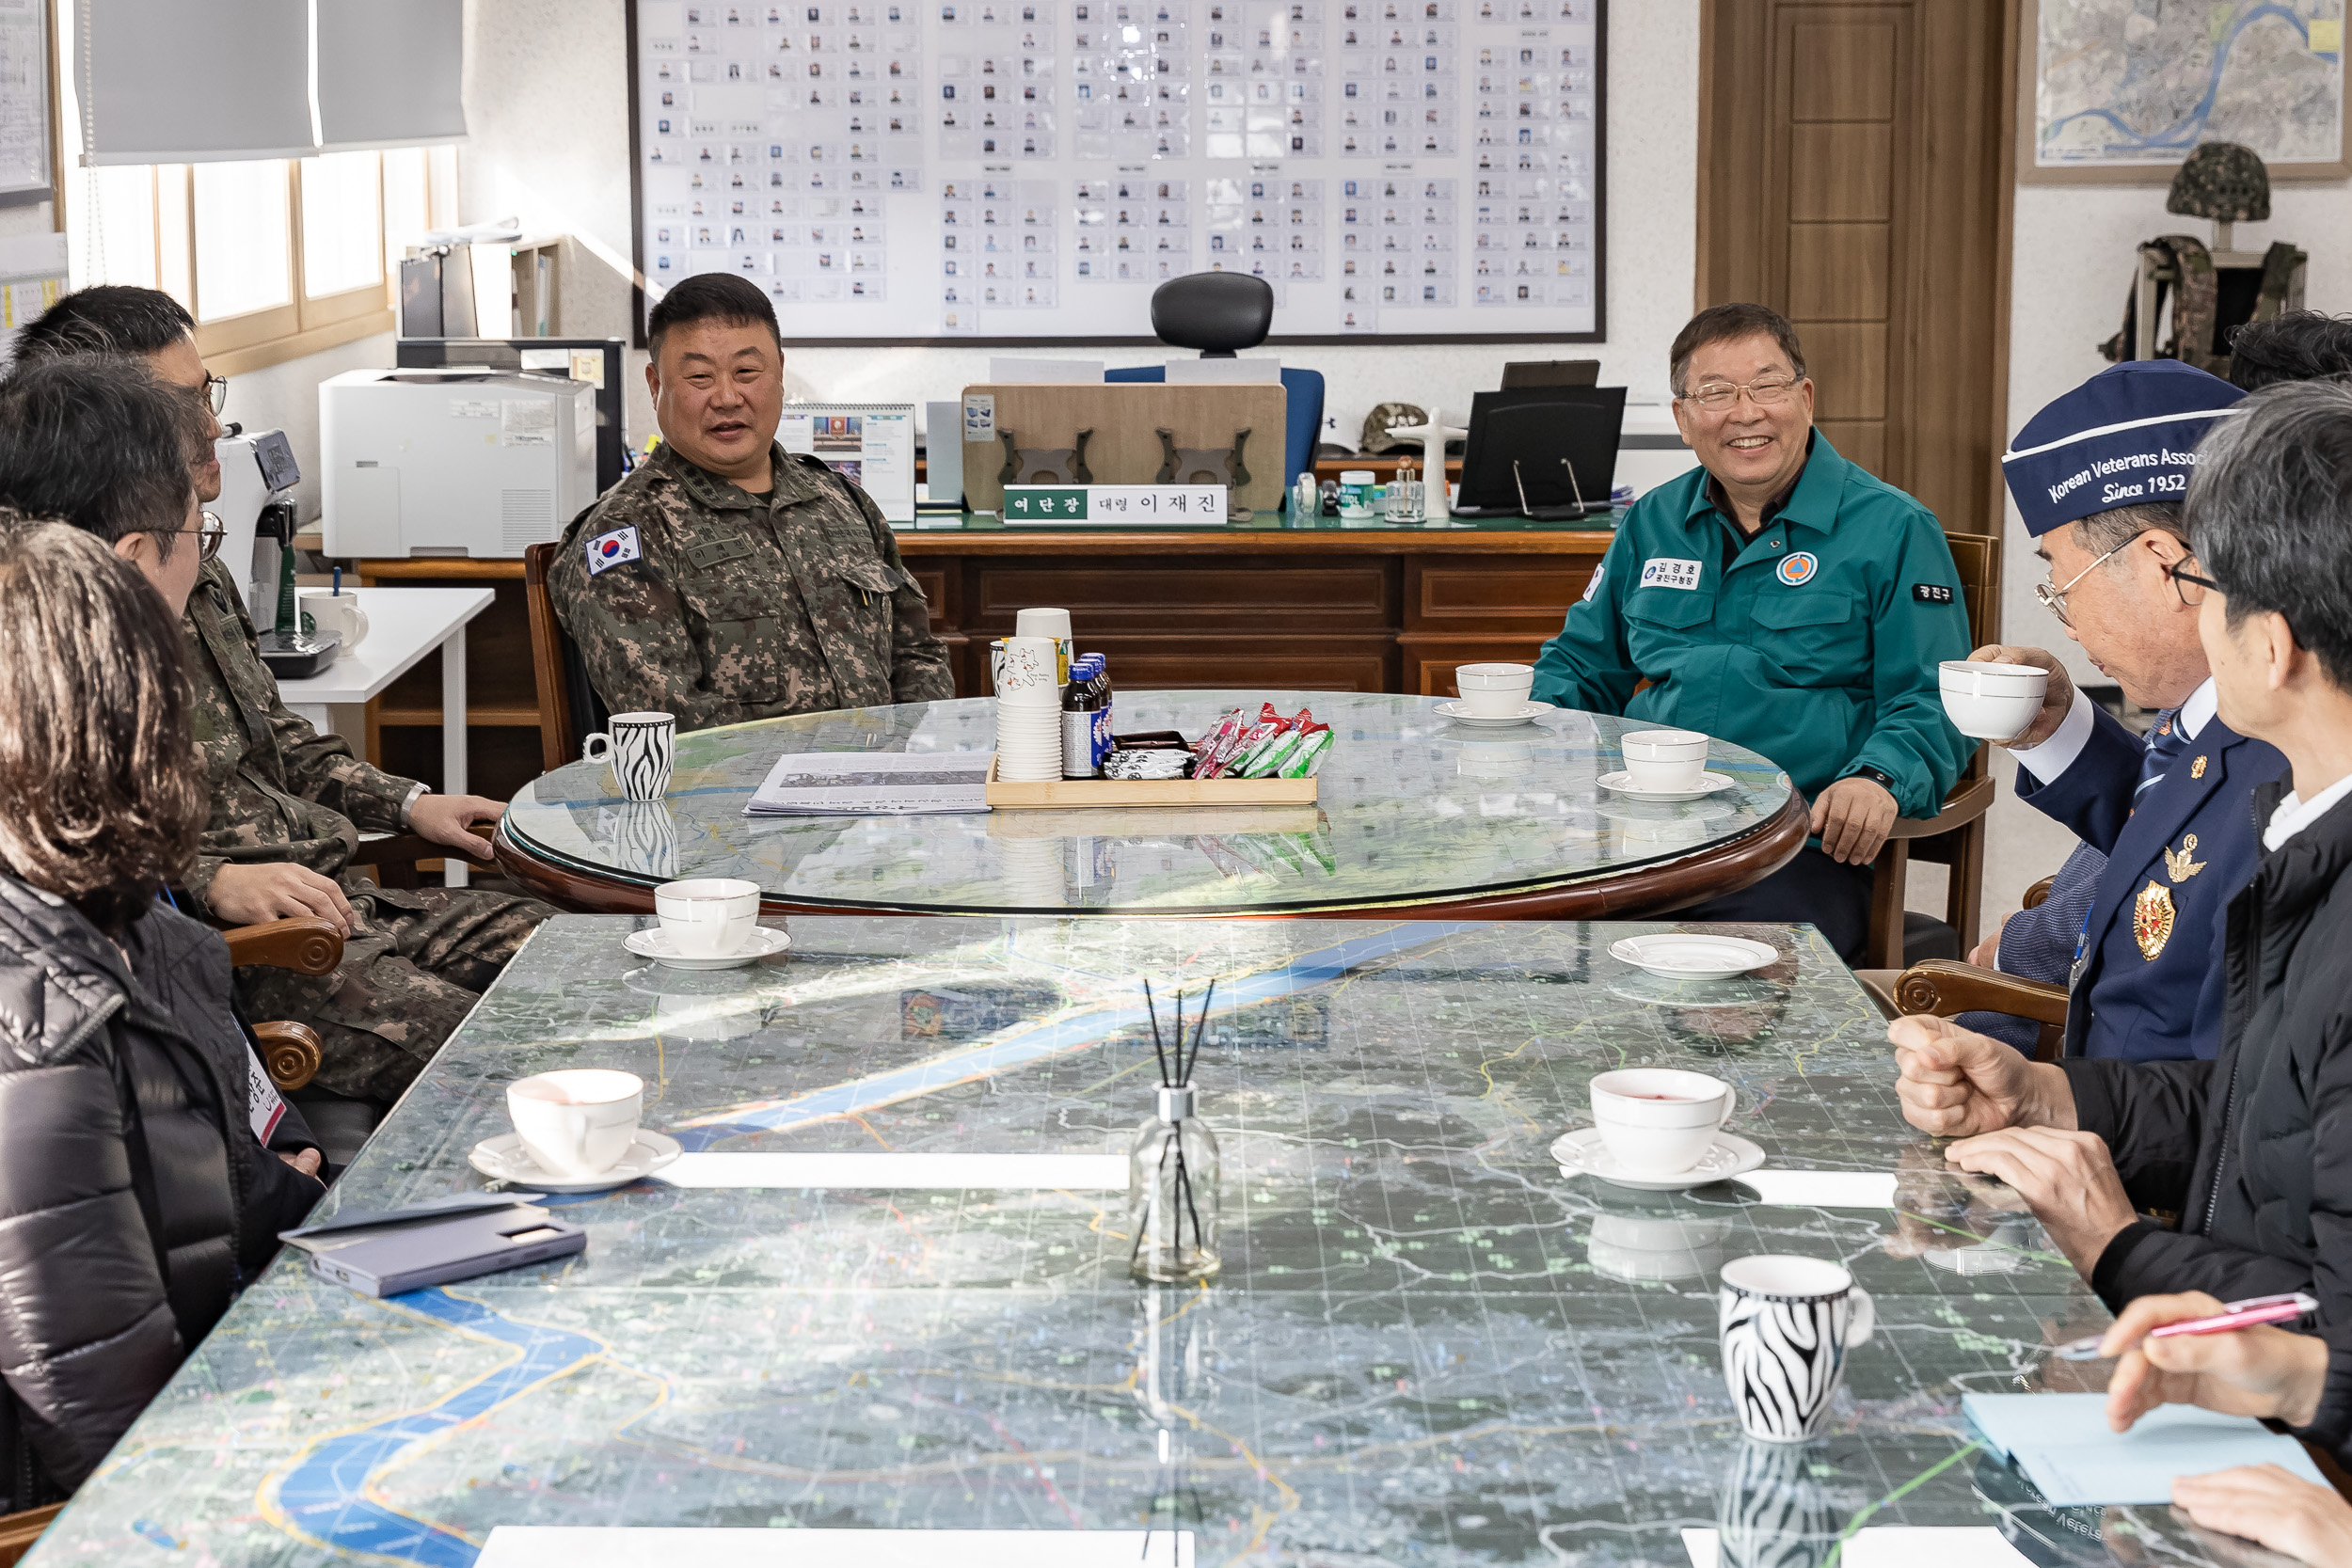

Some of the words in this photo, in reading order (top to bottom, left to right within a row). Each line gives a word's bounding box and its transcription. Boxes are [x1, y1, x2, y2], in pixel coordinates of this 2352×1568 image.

[2048, 469, 2091, 504] Korean
[2090, 453, 2158, 478] Veterans
[2102, 483, 2143, 503] Since
[2148, 474, 2186, 494] 1952
[1014, 497, 1079, 514] 여단장
[1099, 498, 1128, 512] 대령
[1141, 494, 1216, 514] 이재진
[1659, 562, 1694, 575] 김경호
[1656, 574, 1693, 585] 광진구청장
[1919, 585, 1950, 600] 광진구
